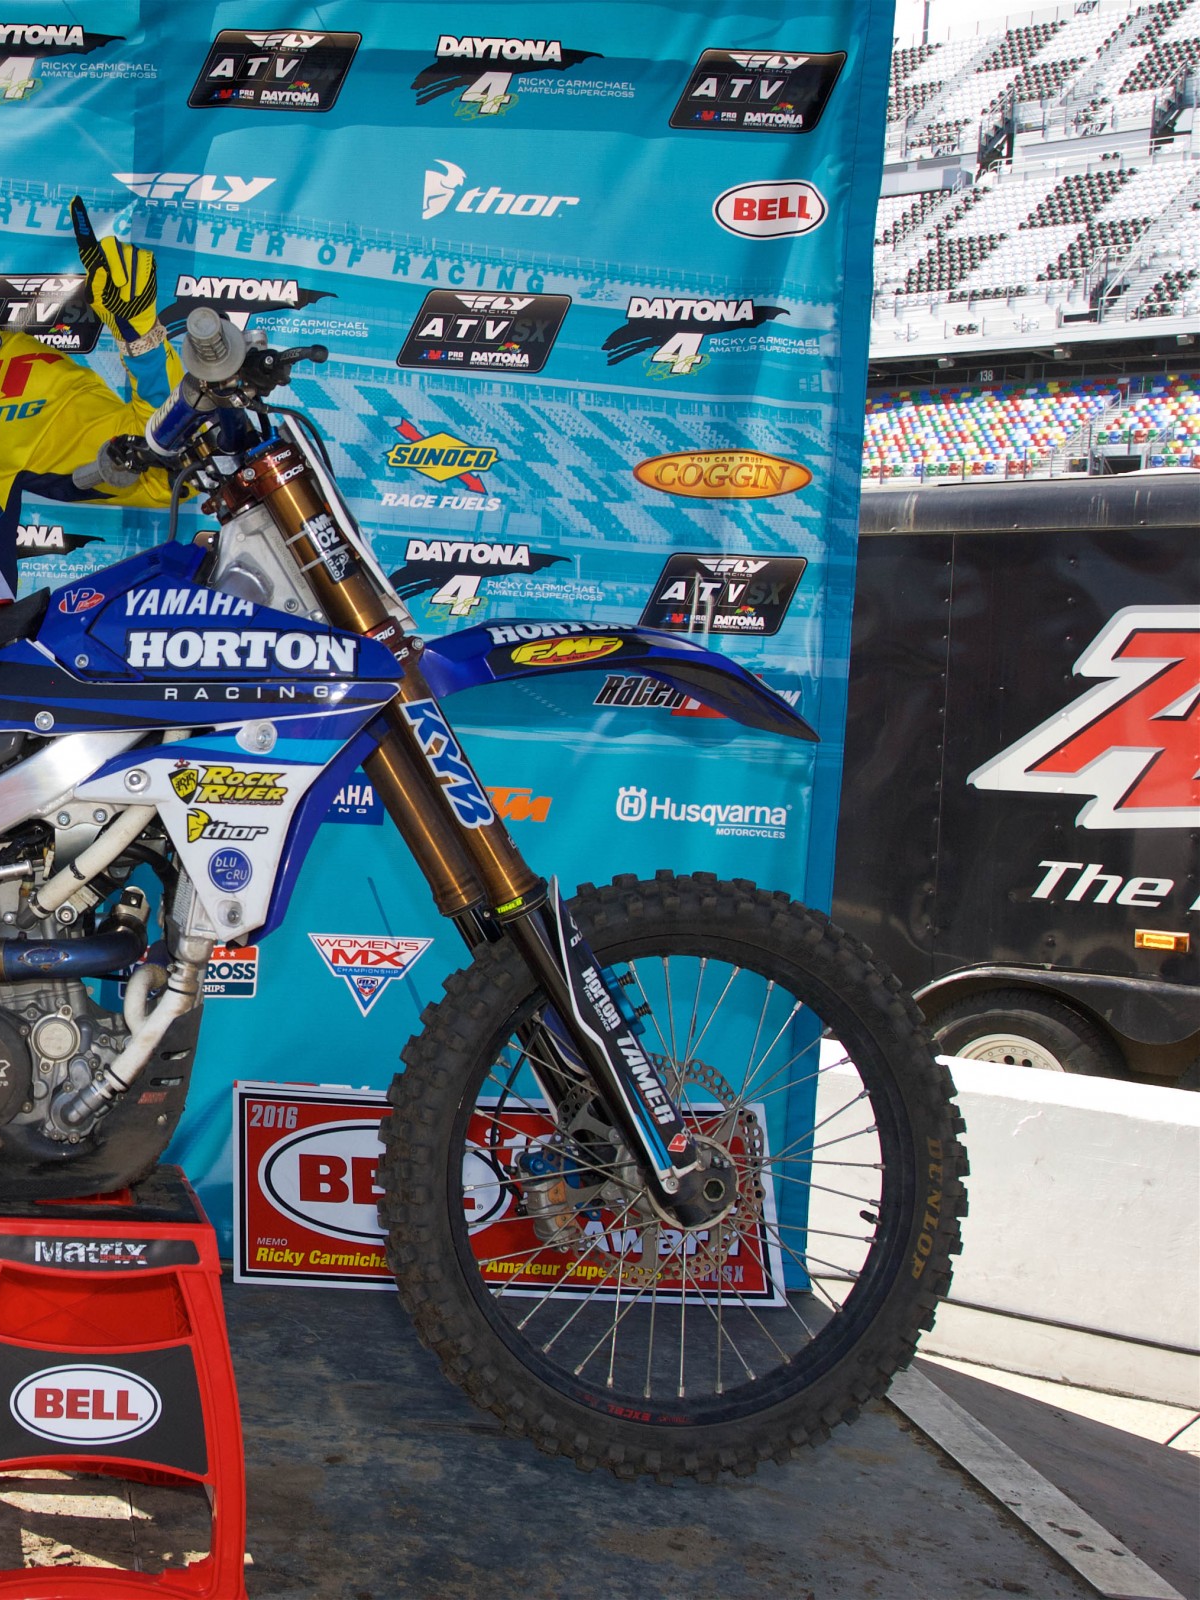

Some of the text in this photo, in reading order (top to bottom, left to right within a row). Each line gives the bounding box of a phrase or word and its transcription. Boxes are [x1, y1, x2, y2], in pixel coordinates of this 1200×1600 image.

[245, 33, 325, 48] FLY
[437, 36, 561, 62] DAYTONA
[41, 62, 158, 72] RICKY CARMICHAEL
[729, 54, 810, 69] FLY
[89, 71, 157, 79] SUPERCROSS
[519, 78, 636, 90] RICKY CARMICHAEL
[261, 91, 319, 102] DAYTONA
[461, 71, 513, 114] 4
[517, 86, 635, 98] AMATEUR SUPERCROSS
[744, 112, 803, 124] DAYTONA
[112, 173, 276, 202] FLY
[145, 201, 239, 211] RACING
[455, 186, 580, 217] thor
[732, 196, 811, 221] BELL
[112, 211, 286, 258] CENTER
[317, 244, 364, 268] OF
[392, 255, 544, 292] RACING
[5, 278, 86, 292] FLY
[177, 276, 298, 301] DAYTONA
[455, 294, 535, 310] FLY
[627, 297, 754, 321] DAYTONA
[256, 317, 369, 330] RICKY CARMICHAEL
[302, 328, 368, 337] SUPERCROSS
[709, 345, 819, 355] AMATEUR SUPERCROSS
[710, 337, 820, 347] RICKY CARMICHAEL
[471, 352, 529, 363] DAYTONA
[651, 332, 704, 374] 4
[980, 370, 993, 382] 138
[392, 447, 493, 468] SUNOCO
[739, 456, 763, 464] TRUST
[654, 462, 790, 491] COGGIN
[380, 493, 502, 512] RACE FUELS
[405, 540, 530, 566] DAYTONA
[22, 562, 56, 571] RICKY
[697, 558, 770, 573] FLY
[430, 574, 482, 616] 4
[486, 589, 603, 601] AMATEUR SUPERCROSS
[487, 580, 603, 594] RICKY CARMICHAEL
[124, 588, 255, 617] YAMAHA
[714, 615, 765, 627] DAYTONA
[126, 630, 358, 672] HORTON
[513, 637, 619, 664] FMF
[165, 685, 330, 700] RACING
[400, 698, 495, 829] KYB
[198, 765, 287, 786] ROCK
[195, 784, 288, 803] RIVER
[485, 786, 552, 822] TM
[650, 796, 787, 827] Husqvarna
[201, 820, 269, 841] thor
[716, 828, 786, 839] MOTORCYCLES
[1031, 860, 1175, 908] The
[316, 938, 419, 951] WOMEN'S
[331, 948, 406, 967] MX
[337, 966, 399, 975] CHAMPIONSHIP
[616, 1032, 676, 1126] TAMER
[250, 1104, 299, 1129] 2016
[911, 1135, 944, 1281] DUNLOP
[257, 1237, 288, 1246] MEMO
[34, 1241, 149, 1265] Matrix
[256, 1247, 561, 1277] Ricky Carmicha Amateur
[34, 1387, 139, 1422] BELL
